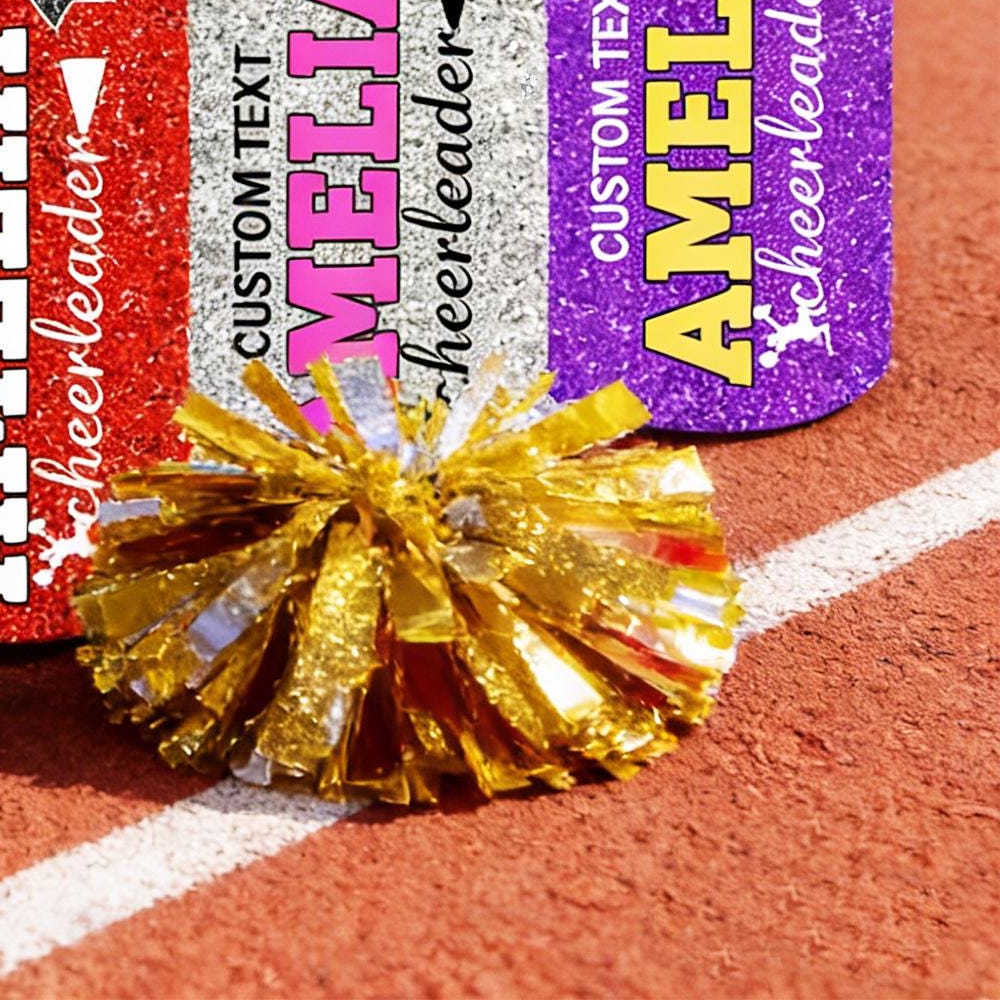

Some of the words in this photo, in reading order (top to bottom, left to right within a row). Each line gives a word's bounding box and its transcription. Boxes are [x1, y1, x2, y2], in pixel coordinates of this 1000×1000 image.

[233, 45, 272, 159] TEXT
[590, 80, 629, 263] CUSTOM
[31, 132, 106, 523] cheerleader
[232, 170, 272, 360] CUSTOM
